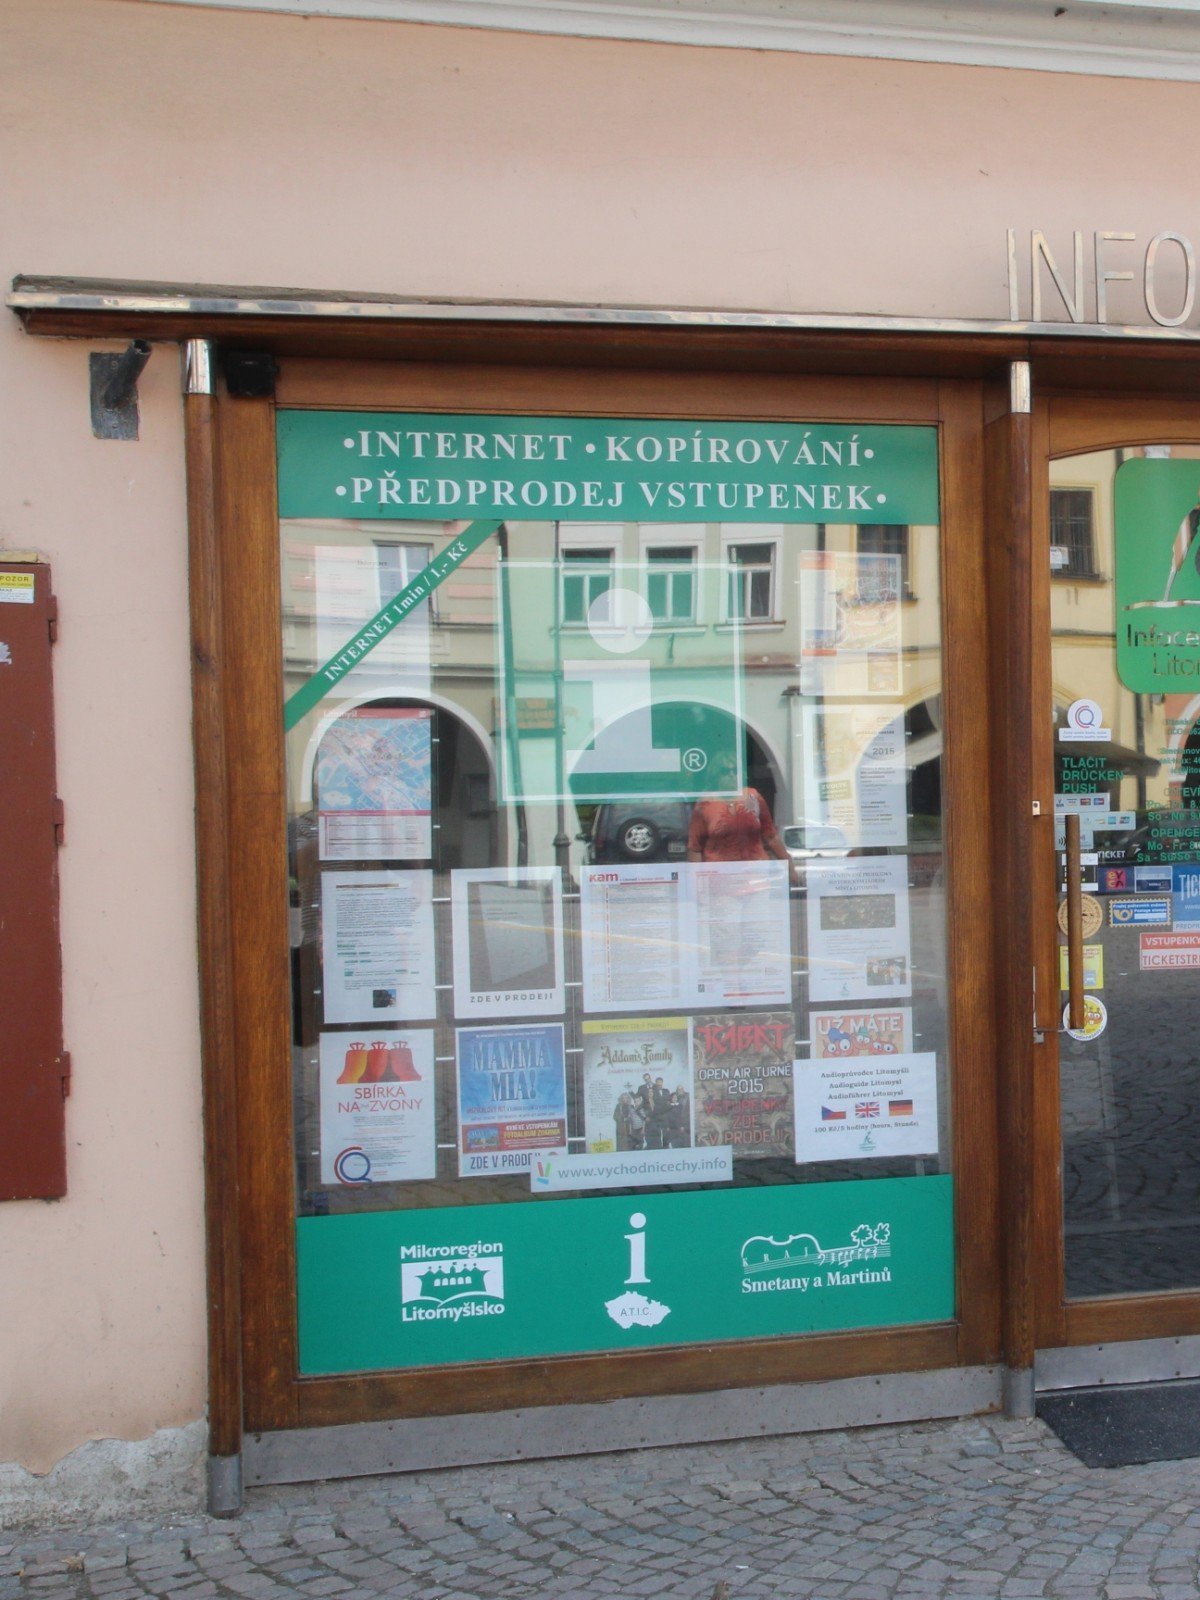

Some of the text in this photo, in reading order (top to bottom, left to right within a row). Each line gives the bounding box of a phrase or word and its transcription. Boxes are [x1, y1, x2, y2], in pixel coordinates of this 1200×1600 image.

[357, 430, 861, 466] INTERNET KOPÍROVÁNÍ
[351, 470, 873, 510] PŘEDPRODEJ VSTUPENEK
[324, 612, 395, 681] INTERNET
[393, 585, 425, 615] 1min
[447, 541, 468, 562] Kč
[1062, 756, 1106, 768] TLAČIT
[1062, 768, 1124, 781] DRÜCKEN
[1062, 783, 1097, 793] PUSH
[1145, 935, 1200, 946] VSTUPENKY
[470, 992, 553, 1004] ZDE V PRODEJI
[850, 1013, 901, 1033] MÁTE
[699, 1063, 792, 1080] OPEN AIR TURNÉ
[354, 1084, 405, 1099] SBÍRKA
[728, 1079, 764, 1094] 2015
[338, 1099, 423, 1113] NA ZVONY
[470, 1156, 488, 1169] ZDE
[492, 1155, 498, 1168] V
[558, 1156, 727, 1178] www.vychodnicechy.info
[401, 1240, 503, 1260] Mikroregion
[742, 1267, 891, 1293] Smetany a Martinů
[402, 1301, 505, 1322] Litomyšlsko
